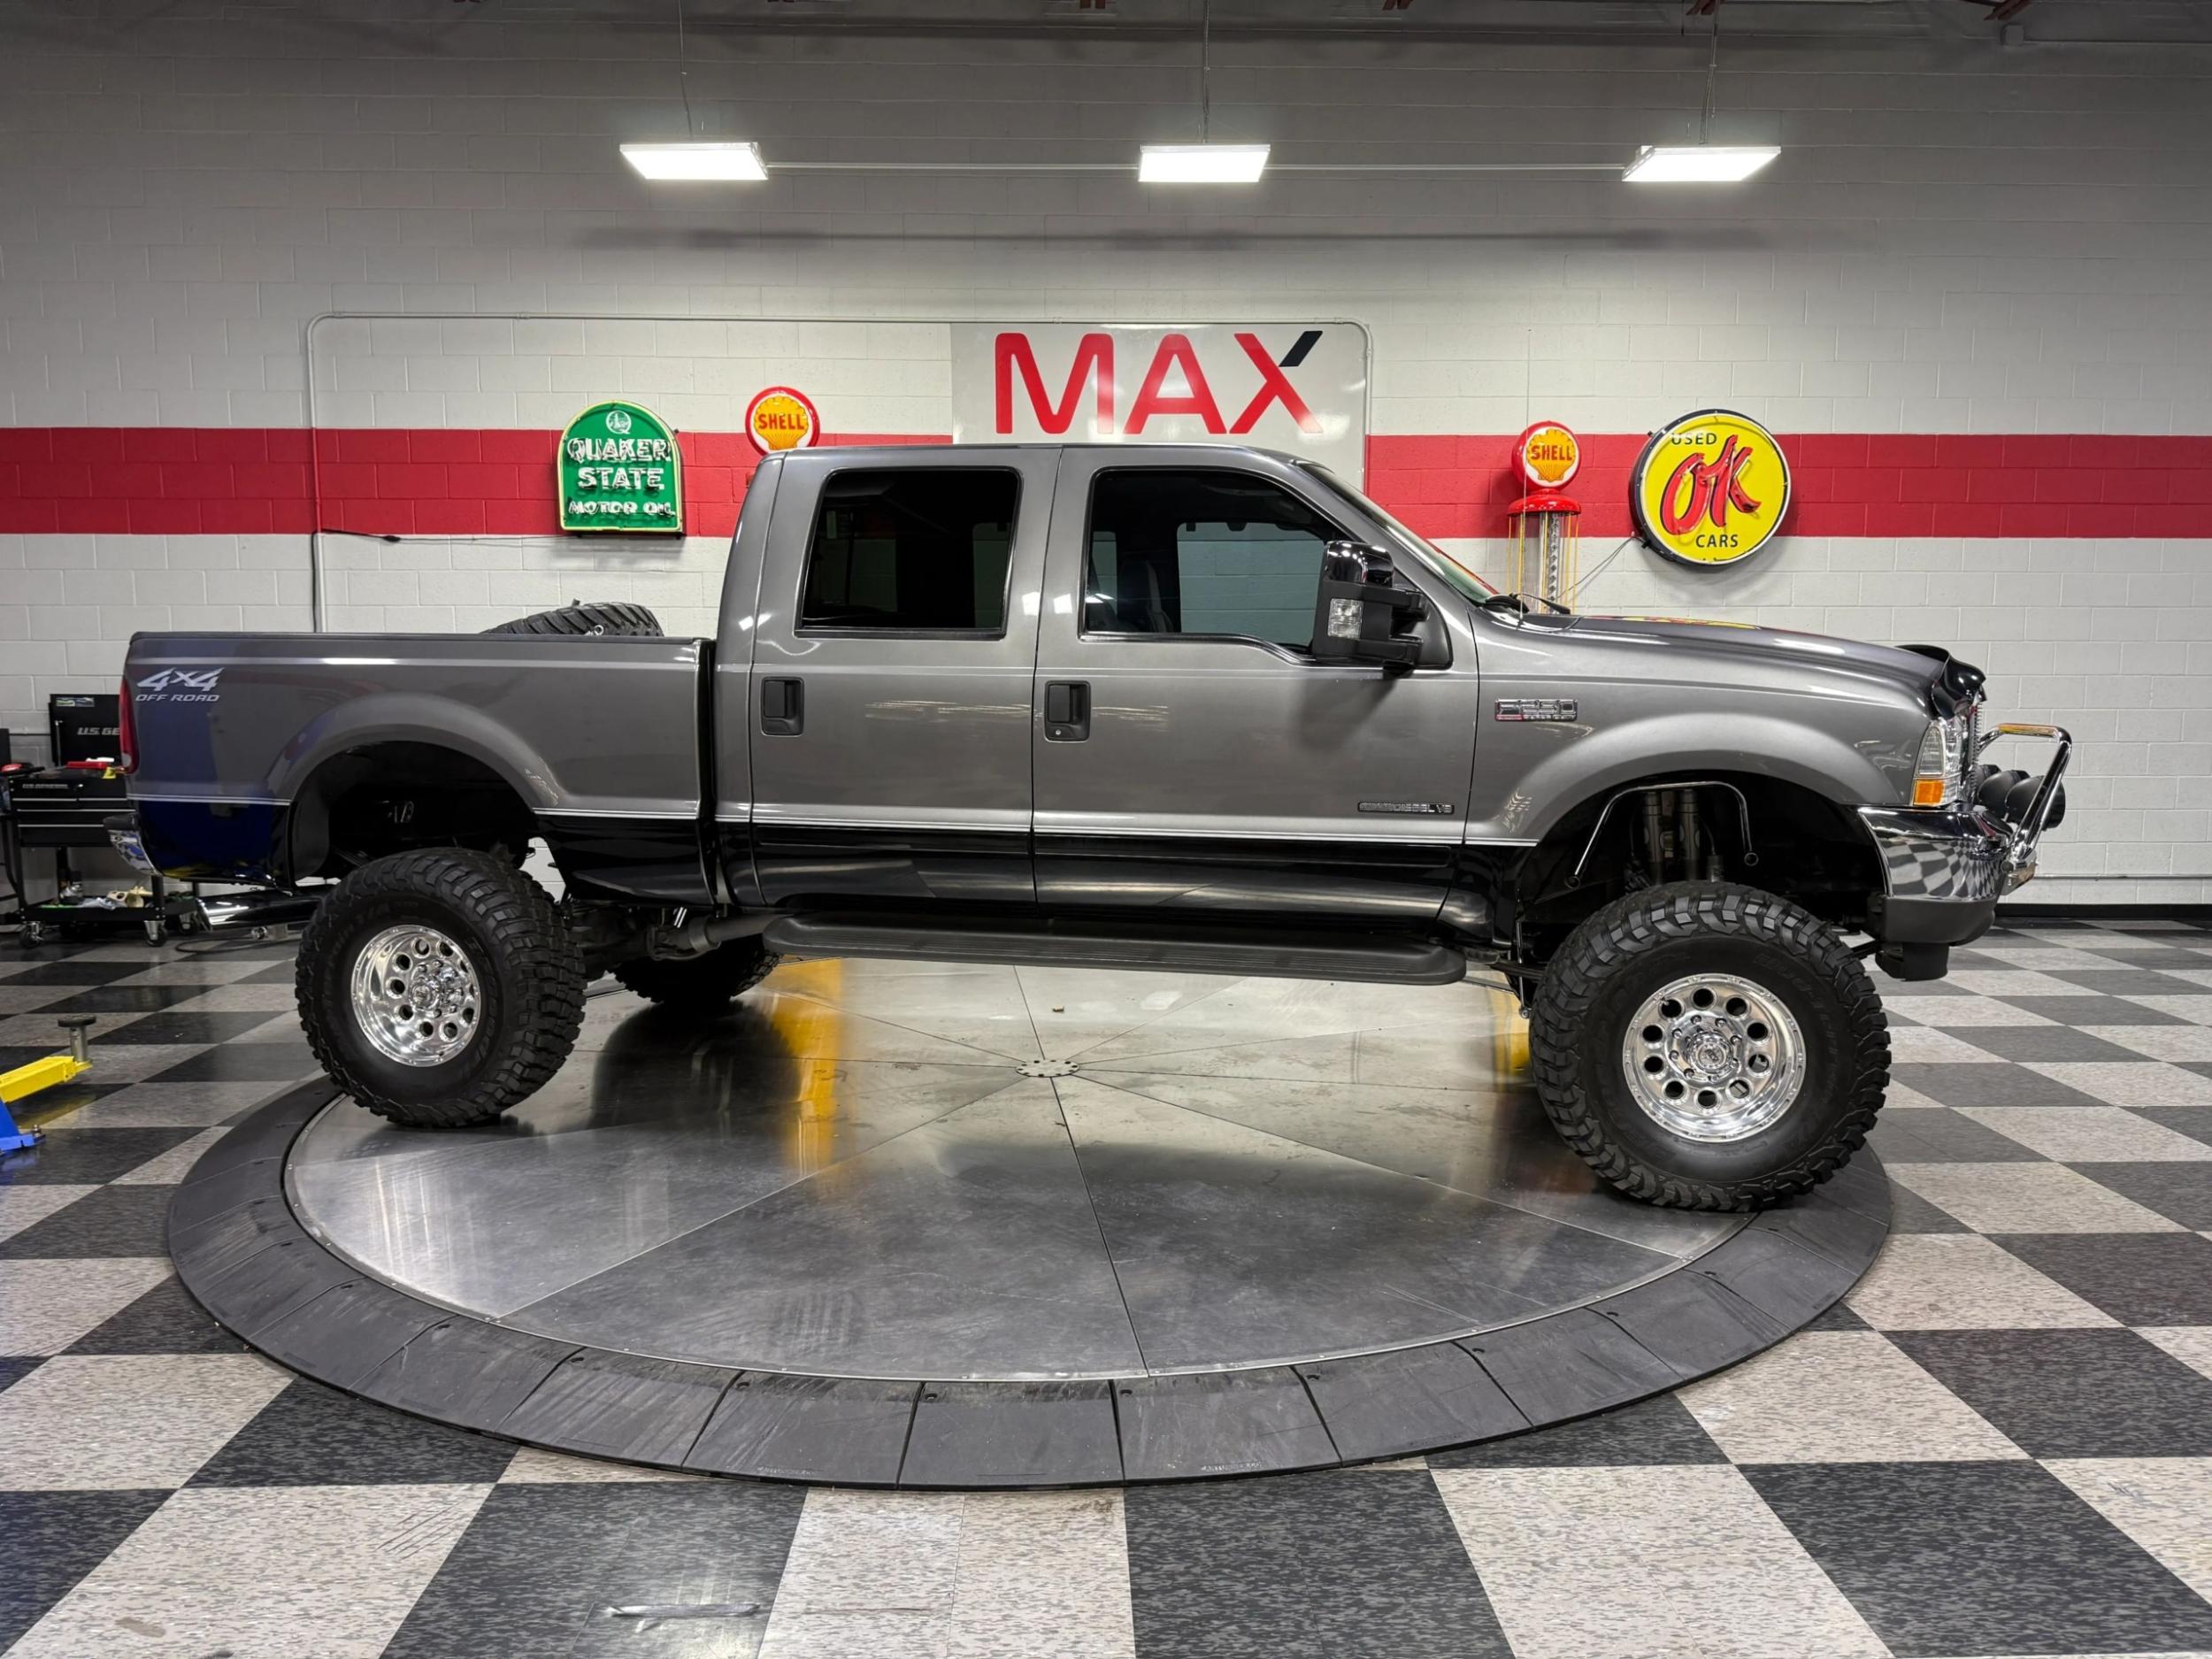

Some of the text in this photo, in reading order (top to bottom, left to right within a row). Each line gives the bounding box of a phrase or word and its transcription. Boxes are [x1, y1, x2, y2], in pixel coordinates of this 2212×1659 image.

[995, 330, 1324, 434] MAX
[758, 412, 804, 430] SHELL
[1671, 432, 1717, 445] USED
[567, 437, 672, 464] QUAKER
[1531, 444, 1572, 461] SHELL
[578, 467, 665, 490] STATE
[1660, 434, 1762, 535] OK
[569, 501, 676, 516] MOTOR OIL
[1695, 534, 1739, 548] CARS
